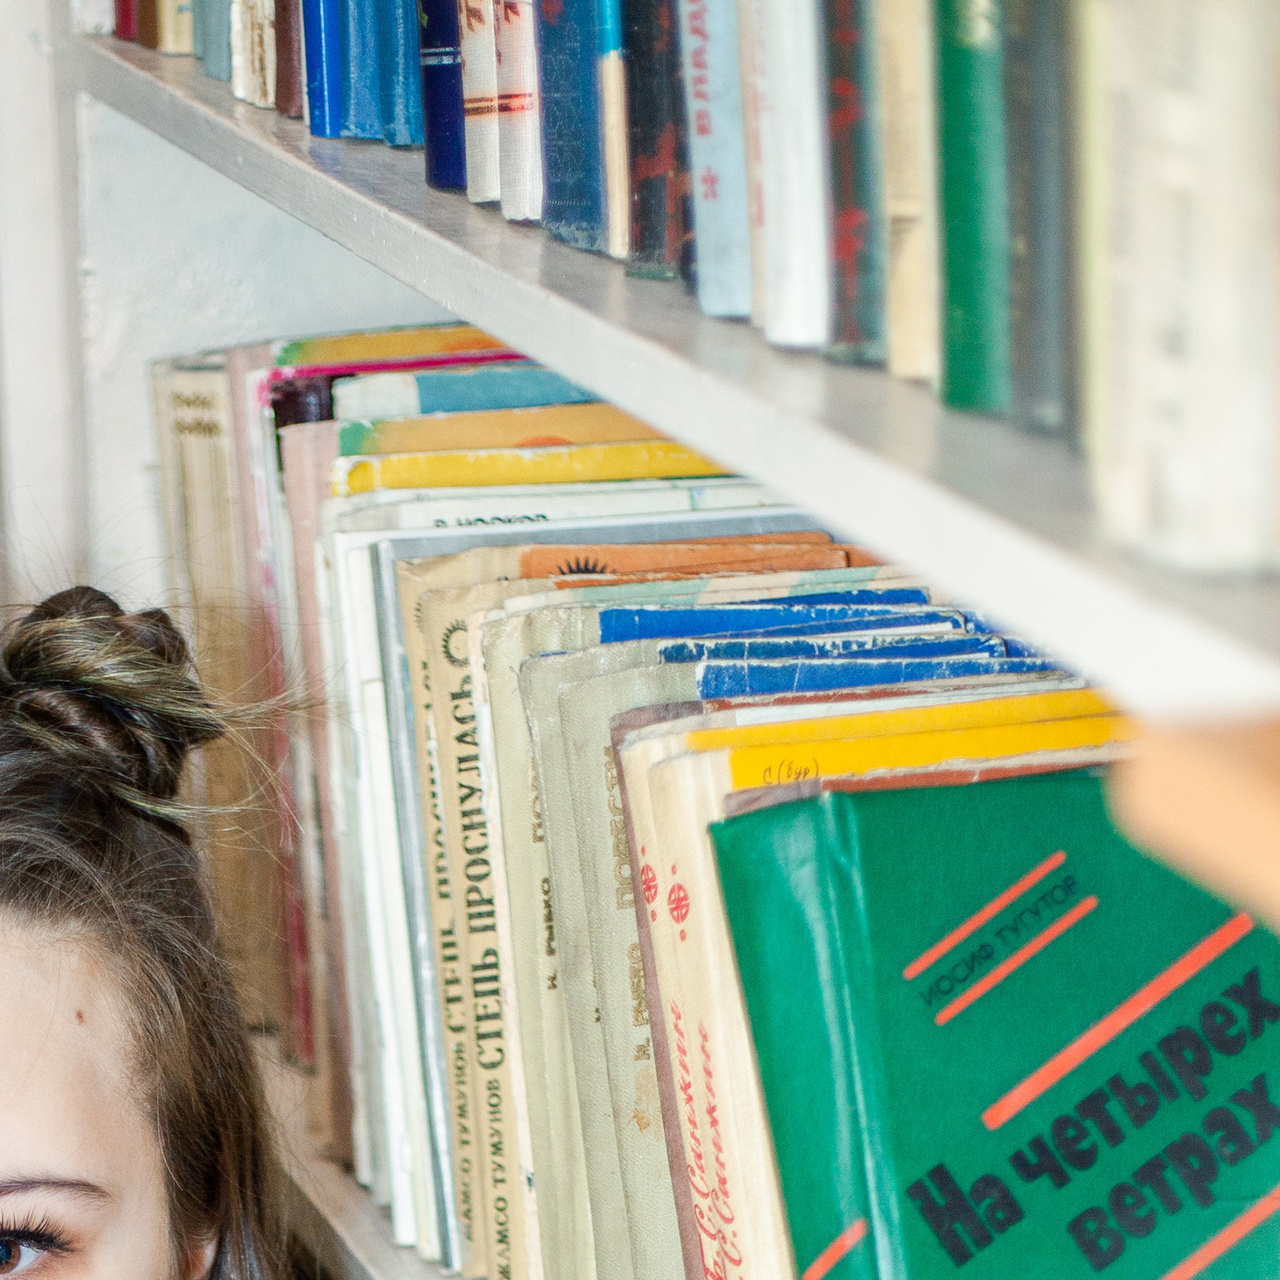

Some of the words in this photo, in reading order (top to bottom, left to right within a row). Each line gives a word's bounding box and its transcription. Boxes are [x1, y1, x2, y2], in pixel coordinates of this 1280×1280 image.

[685, 0, 713, 137] ВЛАД
[447, 675, 499, 935] ПРОСНУЛАСЬ
[470, 950, 506, 1068] СТЕПЬ
[920, 937, 996, 1008] ИОСИФ
[486, 1077, 509, 1189] ТУМУНОВ
[905, 1161, 1026, 1268] На
[1009, 965, 1280, 1191] четырех
[1067, 1071, 1280, 1272] ветрах
